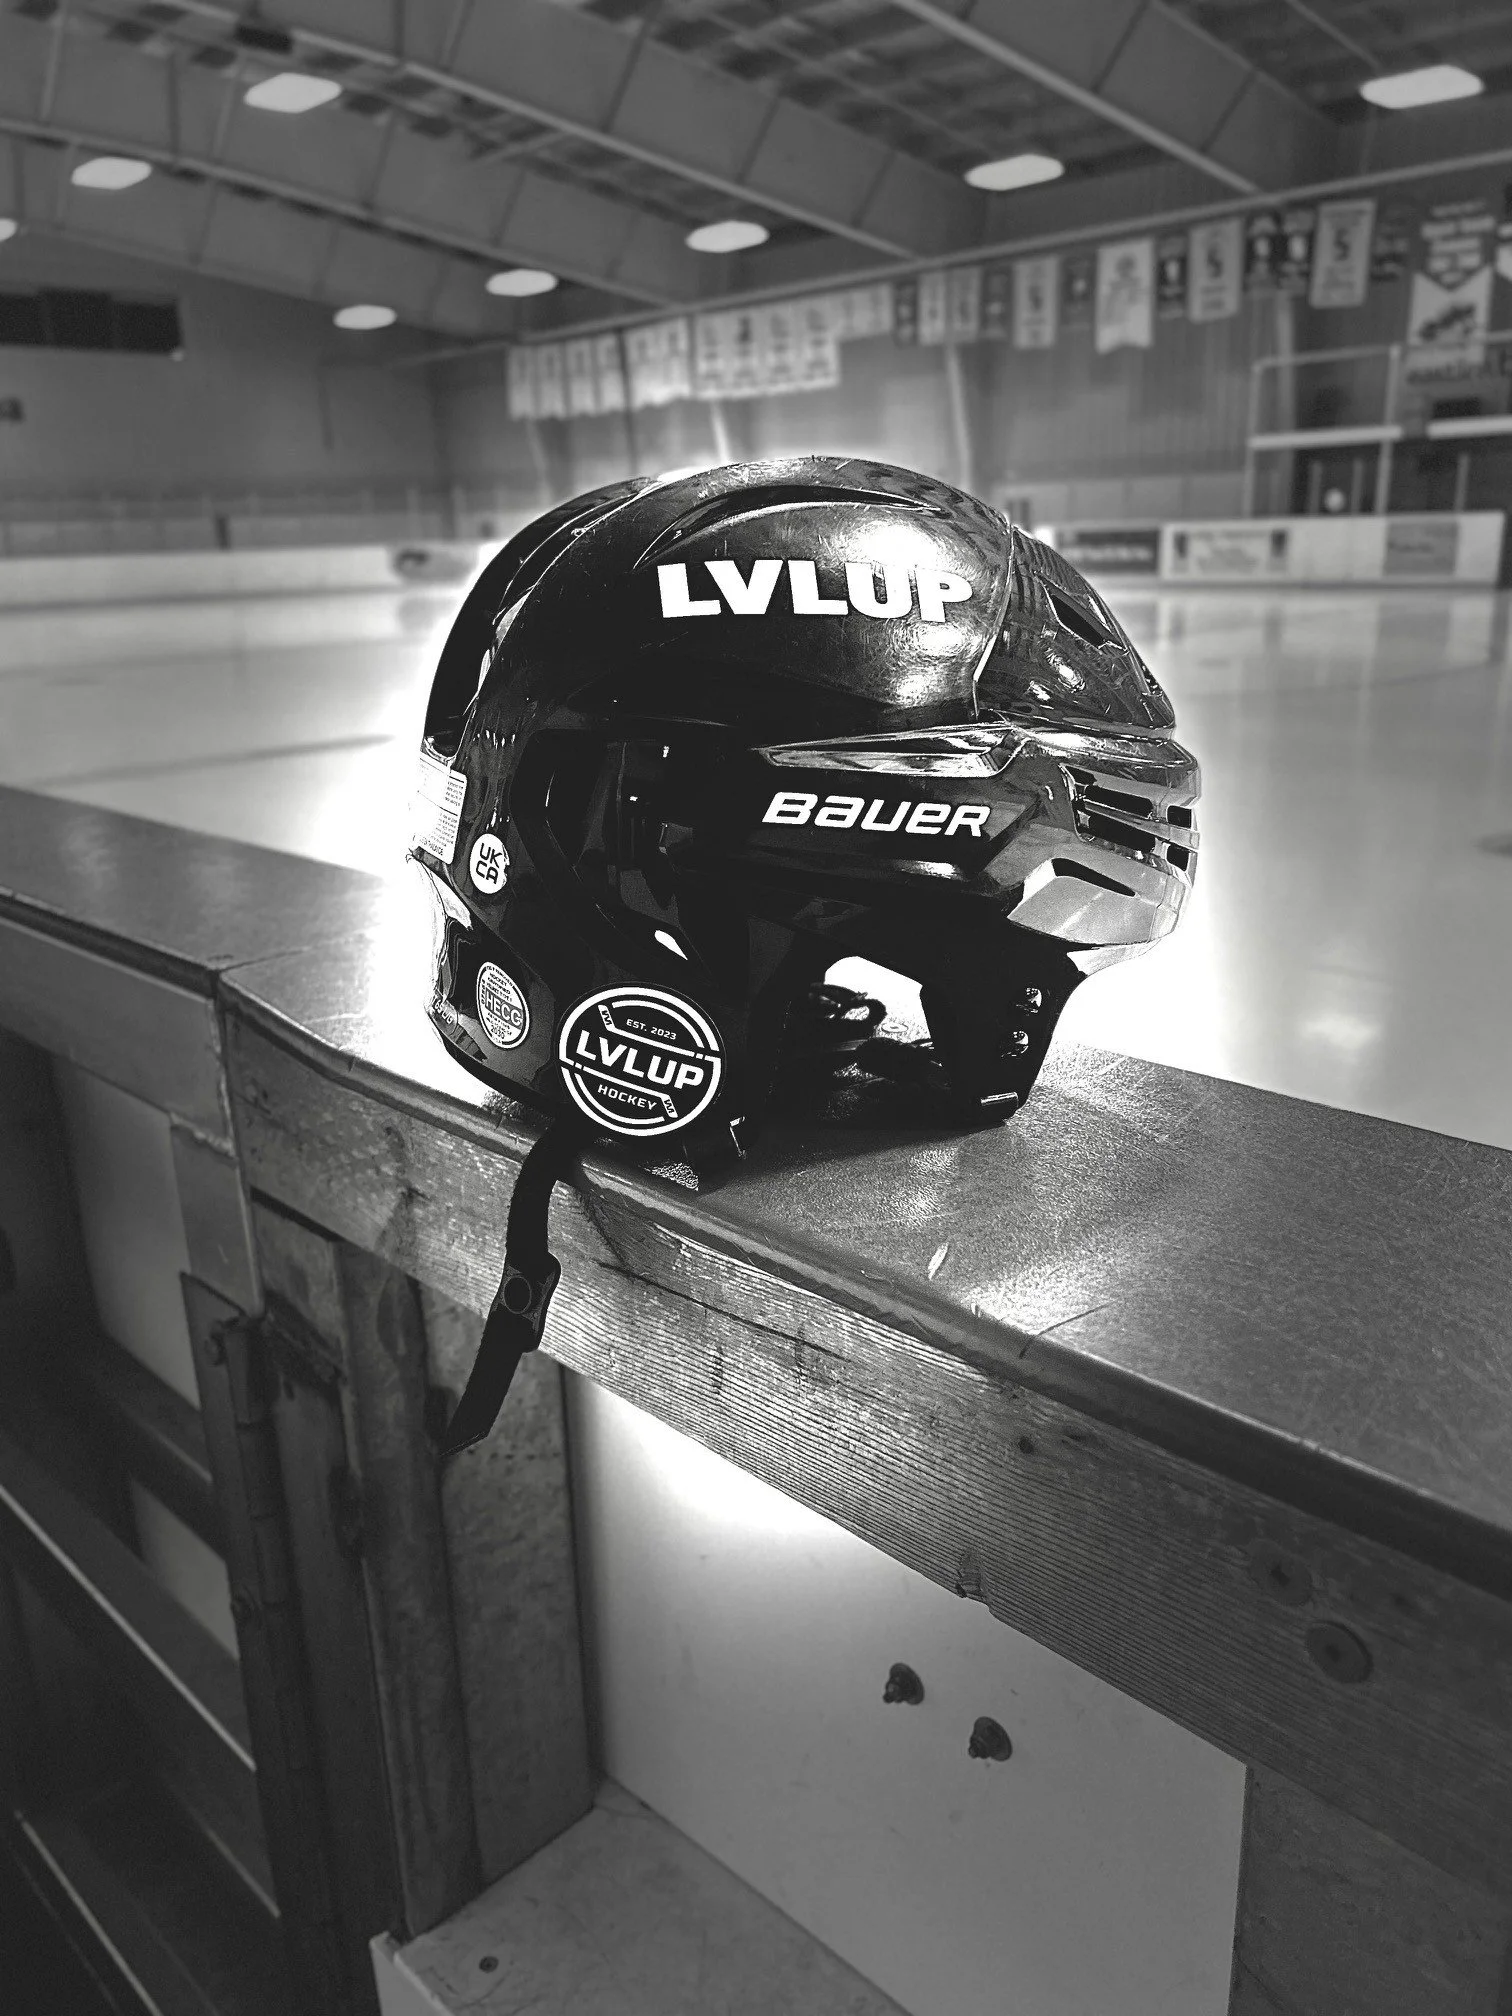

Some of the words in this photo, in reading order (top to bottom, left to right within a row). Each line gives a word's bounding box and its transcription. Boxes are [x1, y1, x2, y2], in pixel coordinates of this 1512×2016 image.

[657, 559, 973, 622] LVLUP
[479, 842, 502, 868] UK
[626, 1018, 648, 1032] EST.
[651, 1026, 677, 1040] 2023
[576, 1029, 704, 1089] LVLUP
[597, 1084, 657, 1110] HOCKEY
